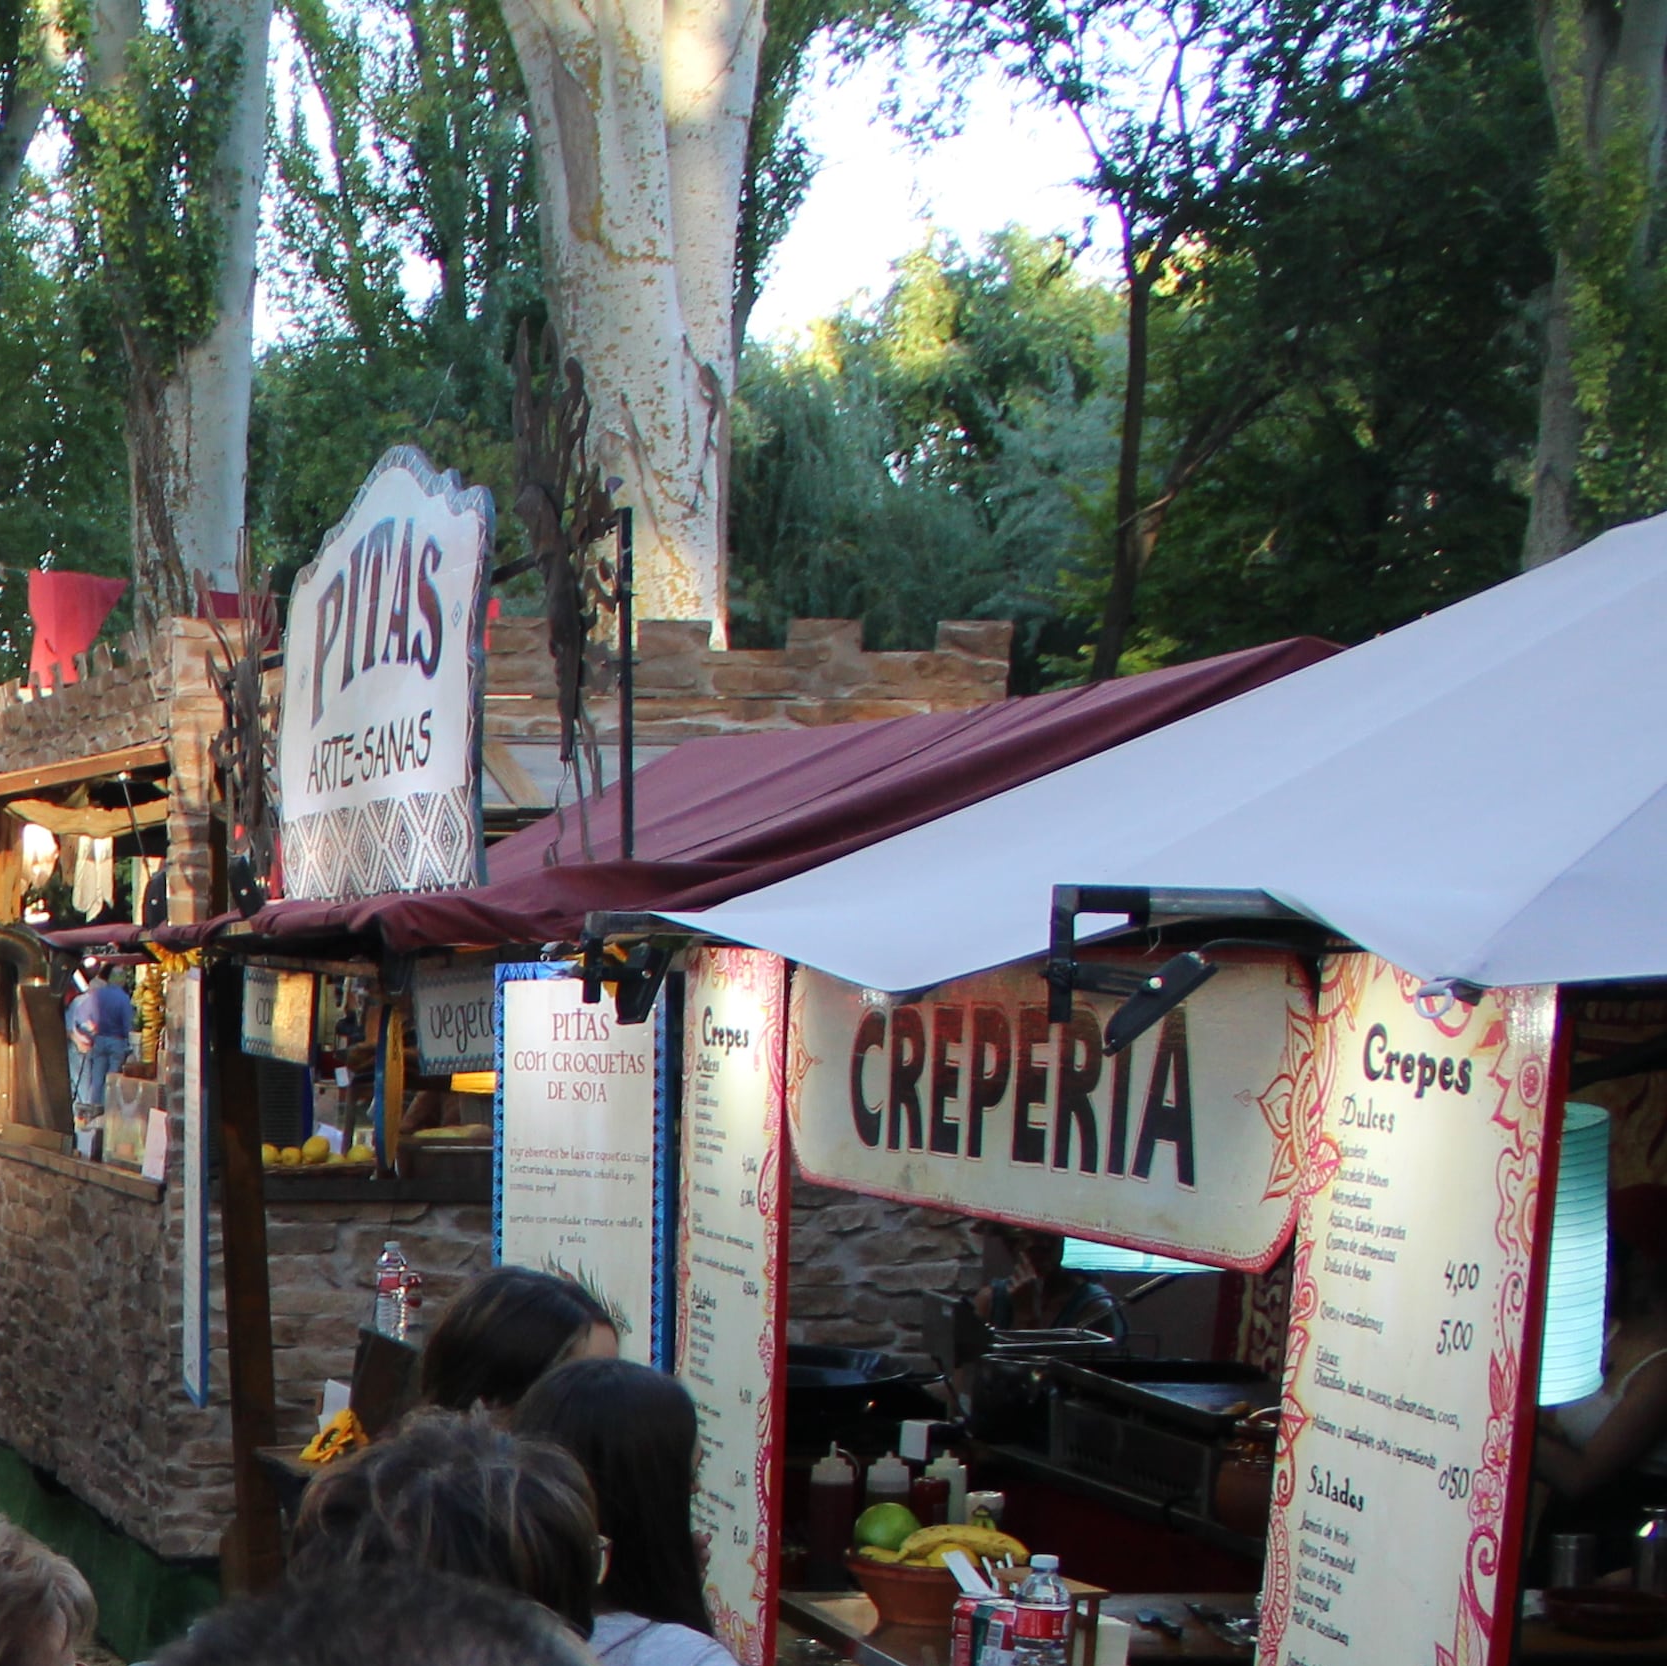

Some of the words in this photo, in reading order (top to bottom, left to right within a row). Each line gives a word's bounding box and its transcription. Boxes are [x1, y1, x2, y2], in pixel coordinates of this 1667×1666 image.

[311, 516, 444, 730] PITAS
[306, 708, 433, 795] ARTE-SANAS
[551, 1008, 610, 1042] PITAS
[701, 1005, 750, 1056] Crepes
[552, 1050, 646, 1077] CROQUETAS
[1362, 1022, 1473, 1099] Crepes
[547, 1080, 569, 1102] DE
[571, 1080, 607, 1104] SOJA
[1338, 1092, 1396, 1134] Dulces
[1444, 1259, 1480, 1298] 4,00
[1436, 1318, 1473, 1355] 5,00
[1306, 1464, 1364, 1512] Salados
